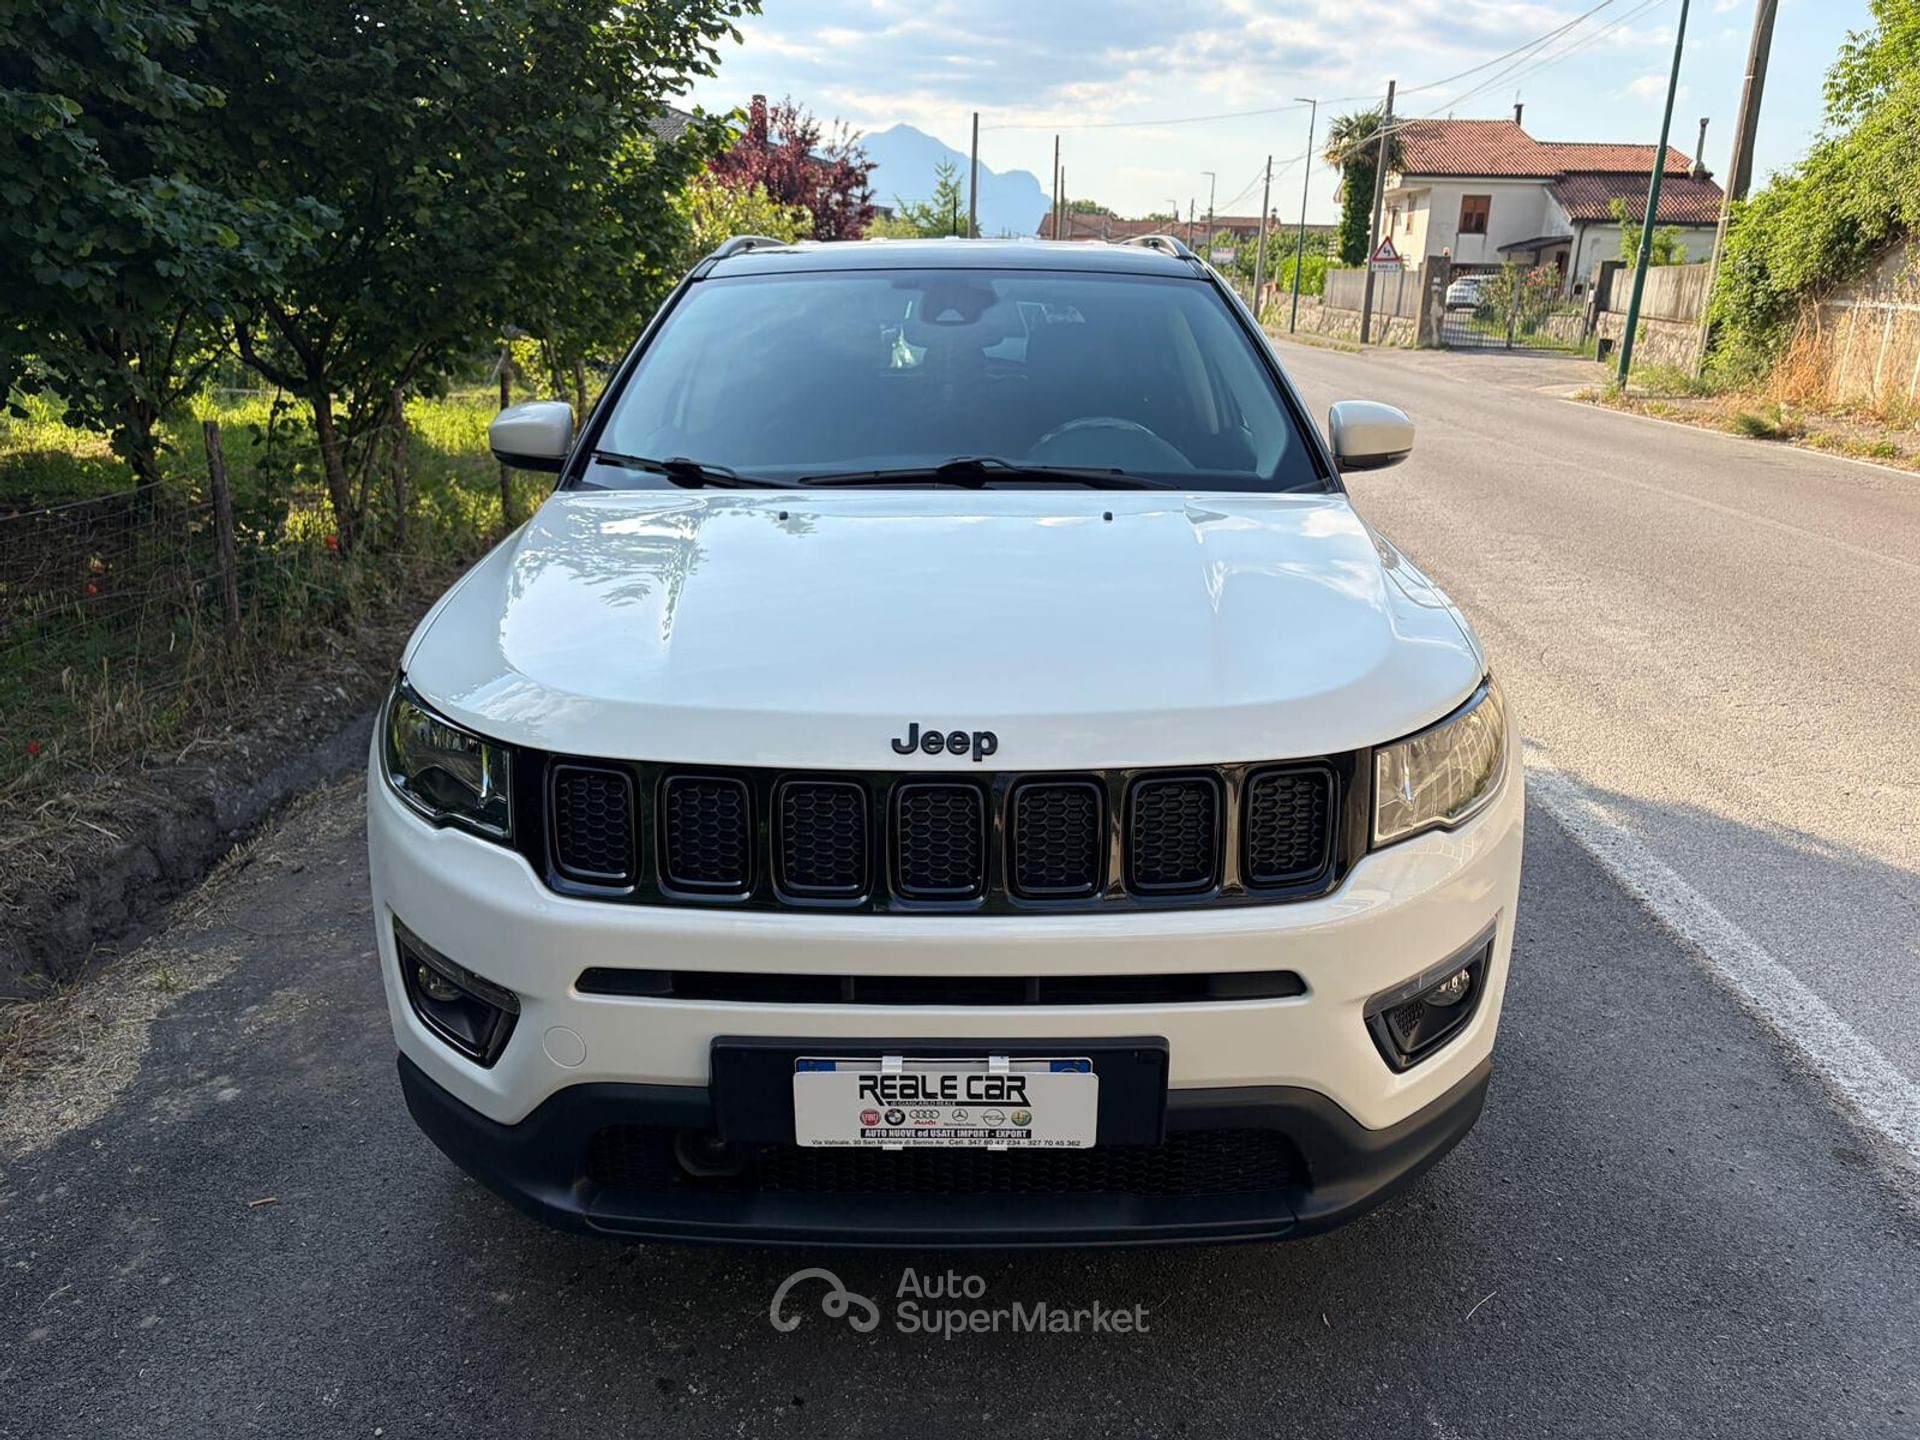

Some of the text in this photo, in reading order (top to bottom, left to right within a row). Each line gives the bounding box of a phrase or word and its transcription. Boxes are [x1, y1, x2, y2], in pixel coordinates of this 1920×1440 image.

[891, 722, 998, 762] Jeep
[865, 1129, 887, 1138] AUTO
[888, 1129, 916, 1138] NUOVE
[917, 1129, 929, 1138] ed
[930, 1129, 956, 1138] USATE
[957, 1129, 990, 1138] IMPORT
[995, 1130, 1028, 1139] EXPORT
